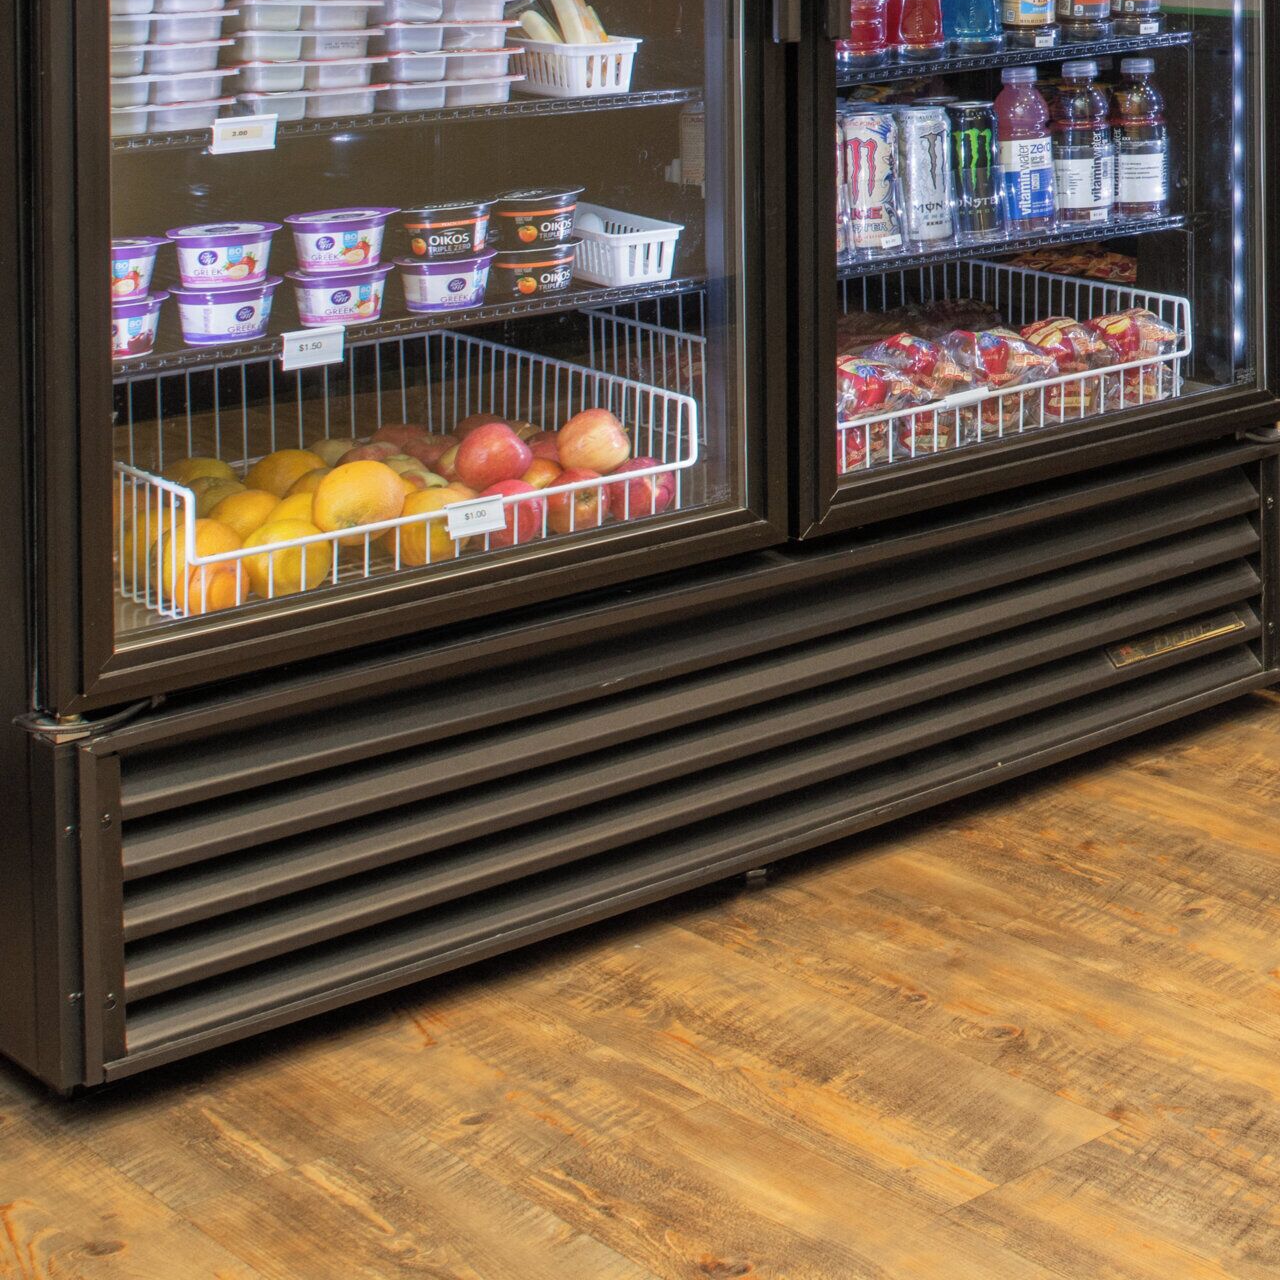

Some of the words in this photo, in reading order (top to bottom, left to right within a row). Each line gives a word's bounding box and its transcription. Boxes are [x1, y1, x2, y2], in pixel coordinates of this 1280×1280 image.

[429, 233, 469, 246] OIKOS
[299, 342, 322, 352] $1.50
[464, 508, 487, 521] $1.00
